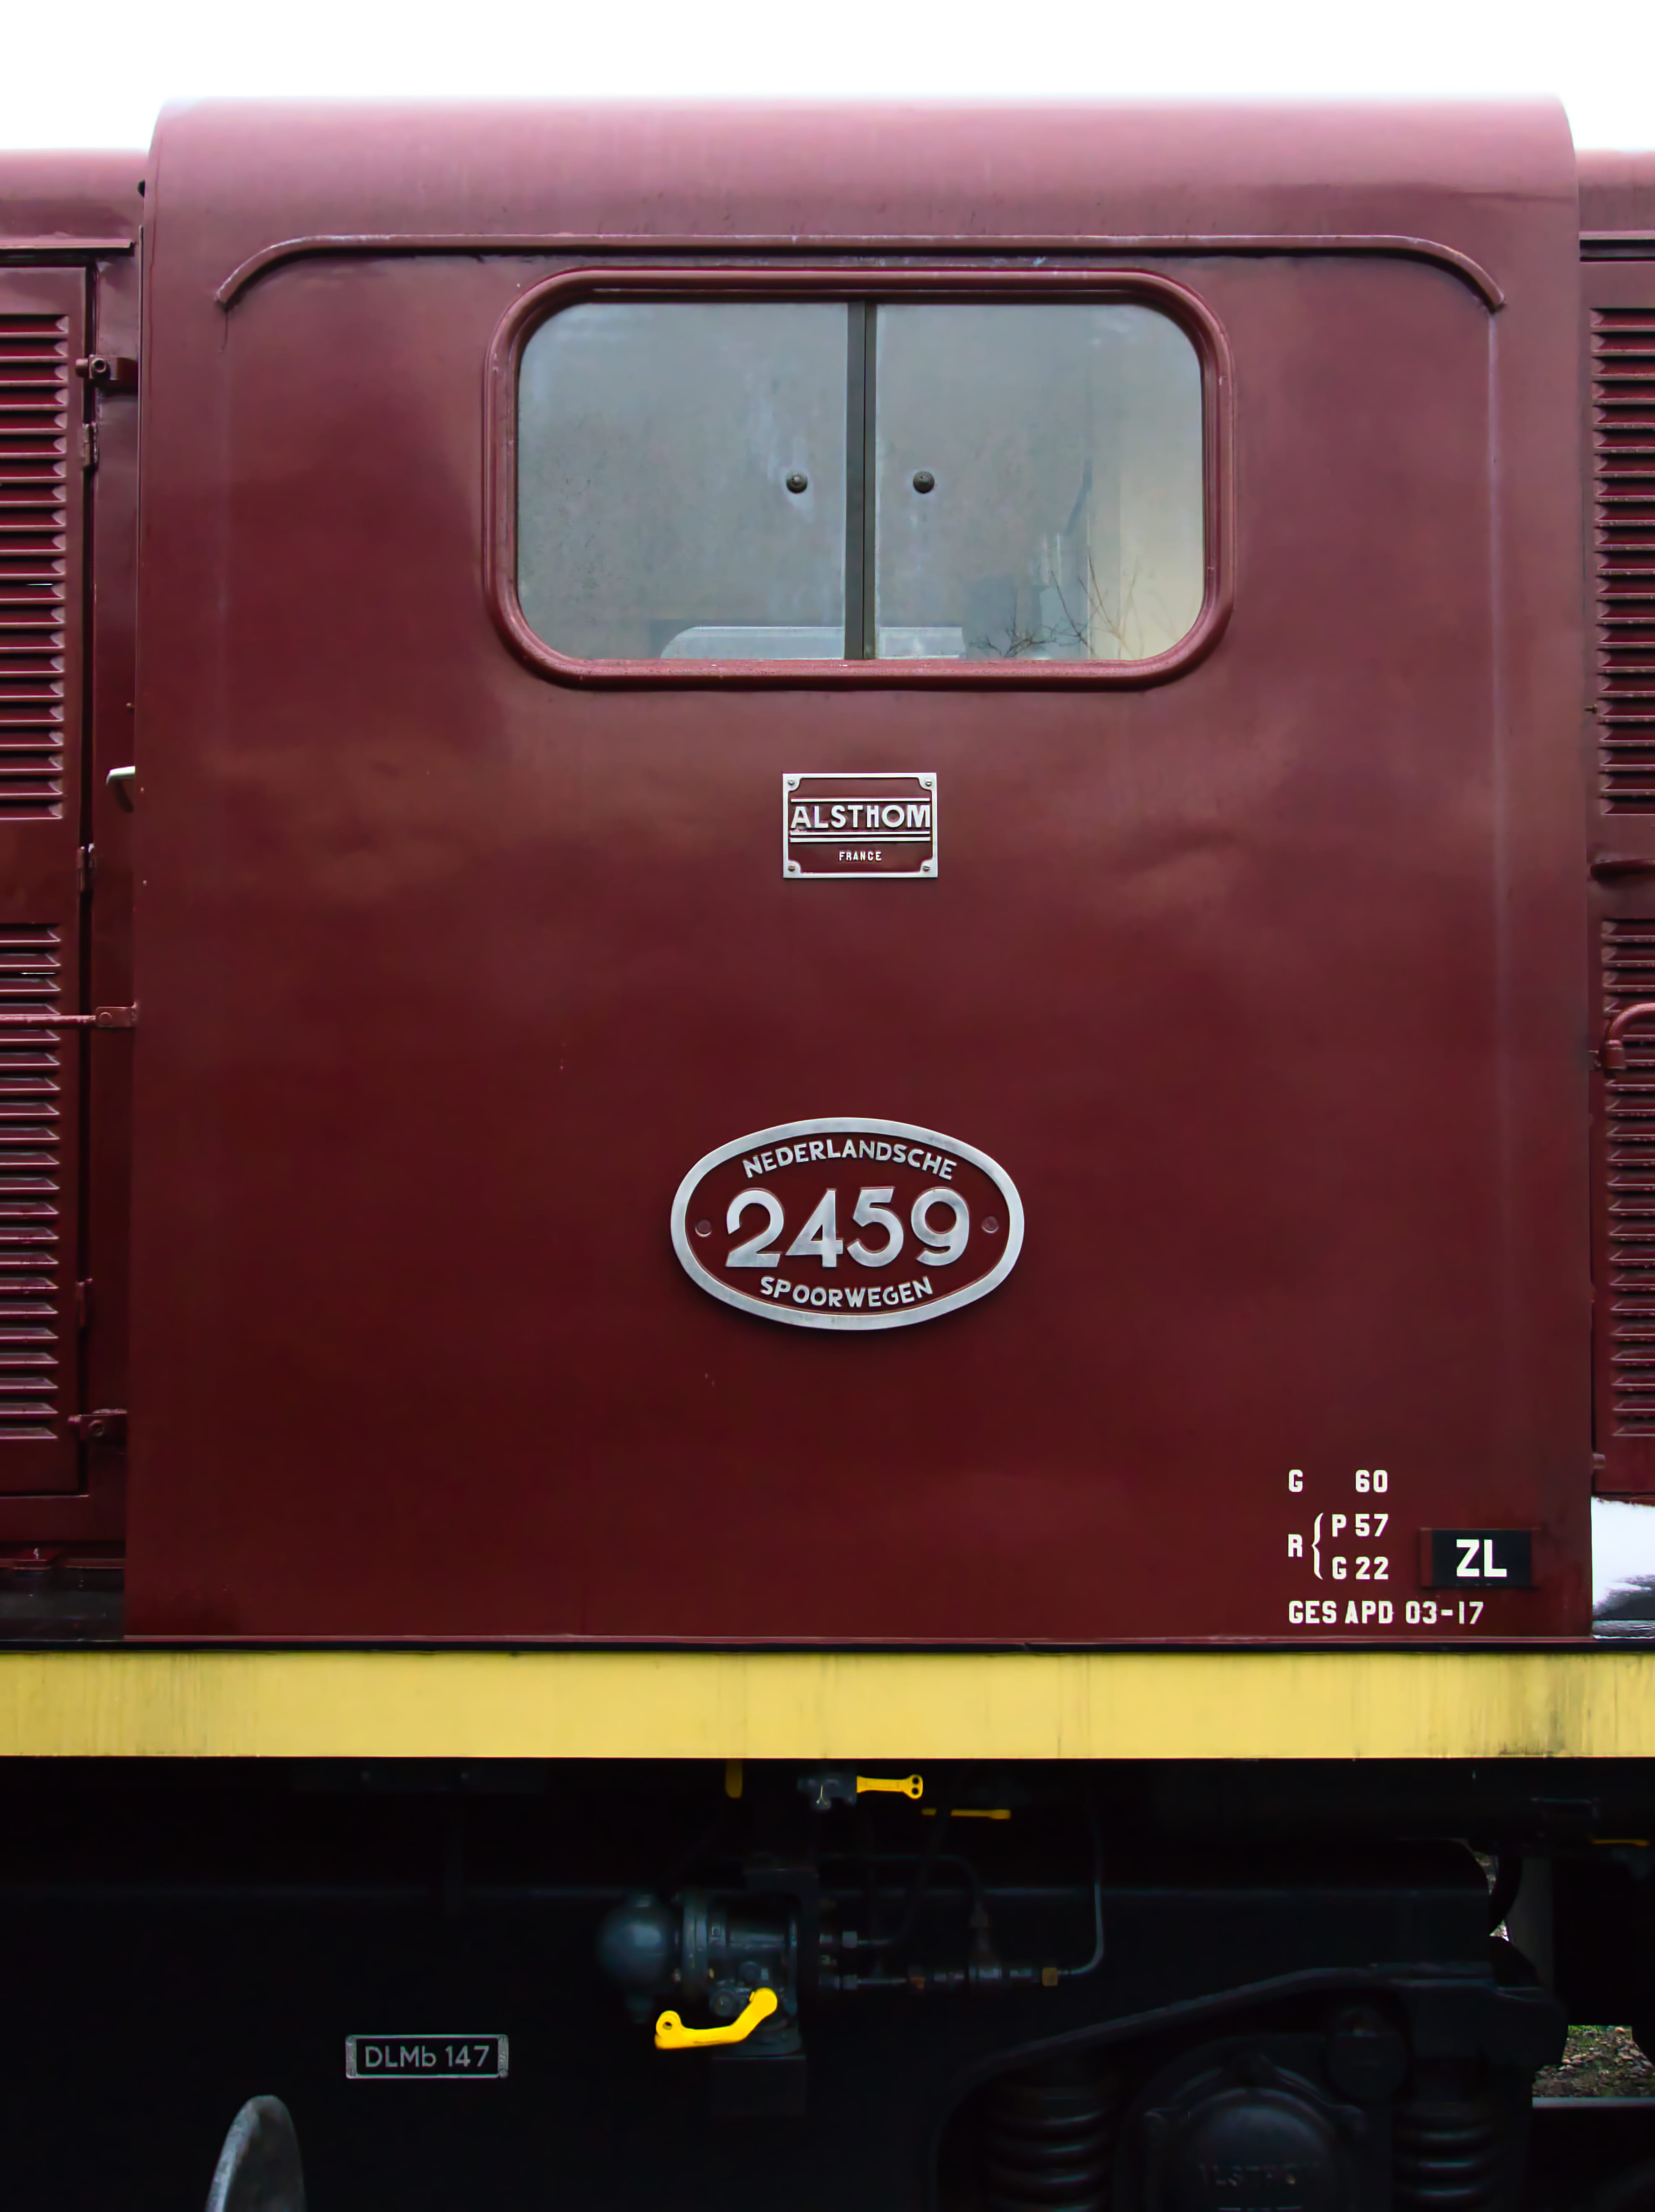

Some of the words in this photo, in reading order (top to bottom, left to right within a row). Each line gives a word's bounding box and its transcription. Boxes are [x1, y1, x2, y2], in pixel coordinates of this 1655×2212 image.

[791, 804, 930, 829] ALSTHOM
[839, 851, 882, 861] FRANCE
[742, 1139, 958, 1180] NEDERLANDSCHE
[726, 1186, 970, 1267] 2459
[760, 1276, 933, 1307] SPOORWEGEN
[1288, 1469, 1303, 1492] G
[1355, 1470, 1388, 1493] 60
[1332, 1514, 1347, 1537] P
[1355, 1513, 1389, 1537] 57
[1288, 1534, 1303, 1557] R
[1332, 1556, 1347, 1580] G
[1355, 1556, 1389, 1580] 22
[1456, 1539, 1507, 1577] ZL
[1289, 1601, 1337, 1624] GES
[1344, 1601, 1393, 1624] APD
[1405, 1601, 1483, 1624] 03-17
[365, 2045, 436, 2067] DLMb
[445, 2045, 489, 2067] 147
